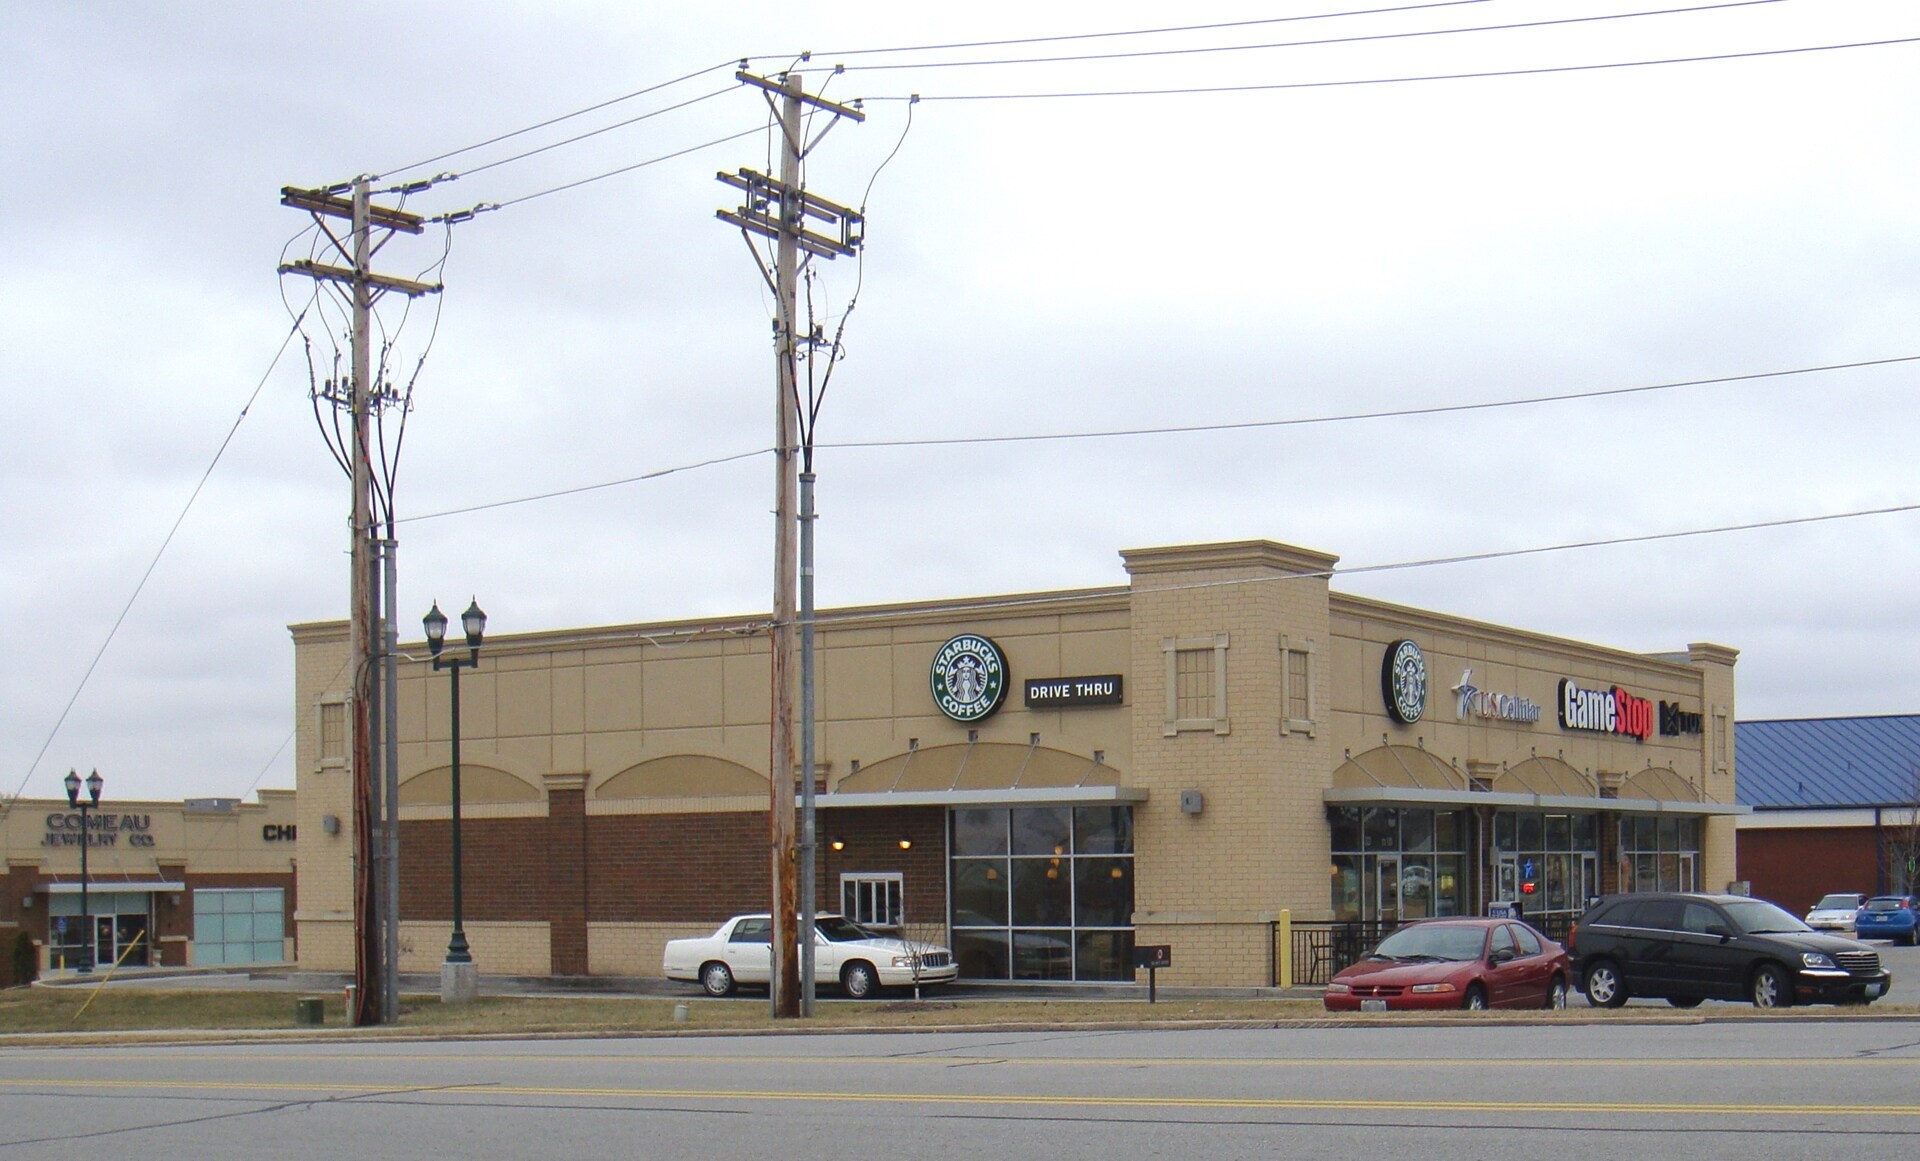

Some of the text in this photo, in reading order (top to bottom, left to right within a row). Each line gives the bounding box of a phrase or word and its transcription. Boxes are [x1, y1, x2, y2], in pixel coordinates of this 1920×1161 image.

[935, 638, 999, 676] STARBUCKS
[1030, 682, 1113, 700] DRIVE THRU
[942, 694, 991, 717] COFFEE
[1398, 696, 1422, 719] COFFEE
[1500, 695, 1541, 722] Cellular
[1564, 681, 1654, 741] GameStop
[46, 813, 151, 831] COMEAU
